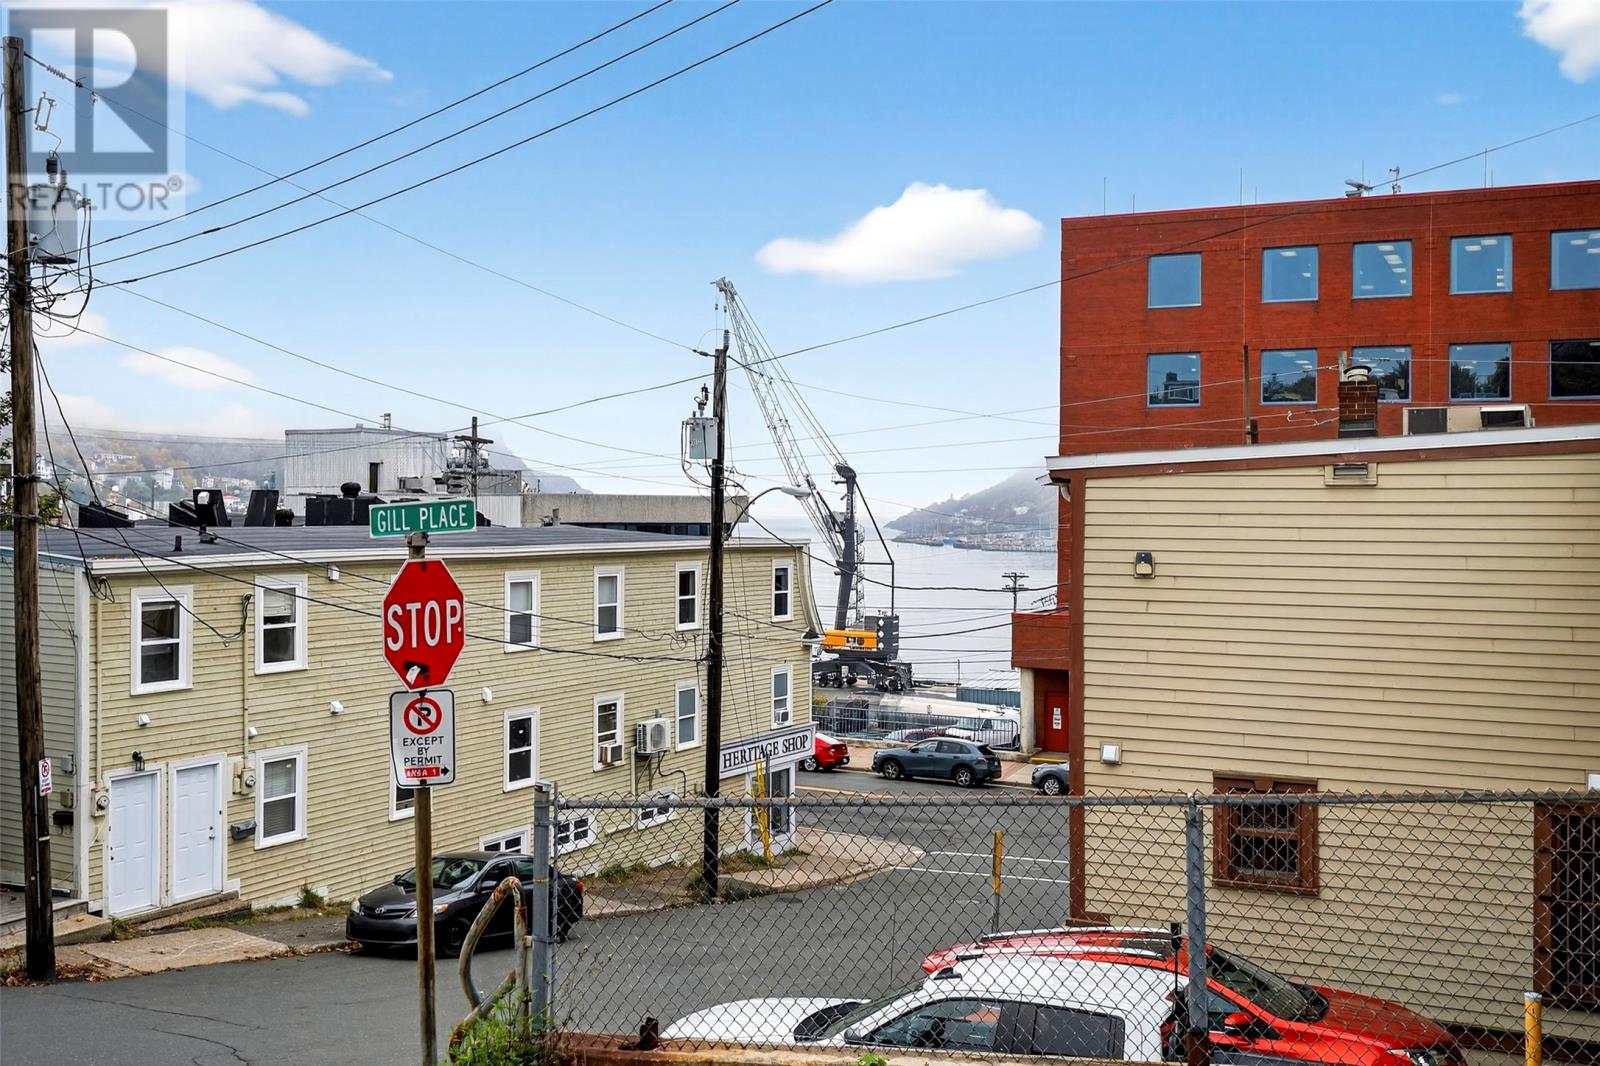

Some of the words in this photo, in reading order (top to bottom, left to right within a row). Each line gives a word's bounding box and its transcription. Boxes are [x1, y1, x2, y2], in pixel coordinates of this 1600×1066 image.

[377, 508, 410, 532] GILL
[420, 504, 468, 529] PLACE
[386, 599, 462, 651] STOP
[402, 736, 444, 746] EXCEPT
[404, 755, 442, 766] PERMIT
[417, 747, 430, 755] BY
[722, 741, 779, 769] HERITAGE
[782, 734, 808, 753] SHOP
